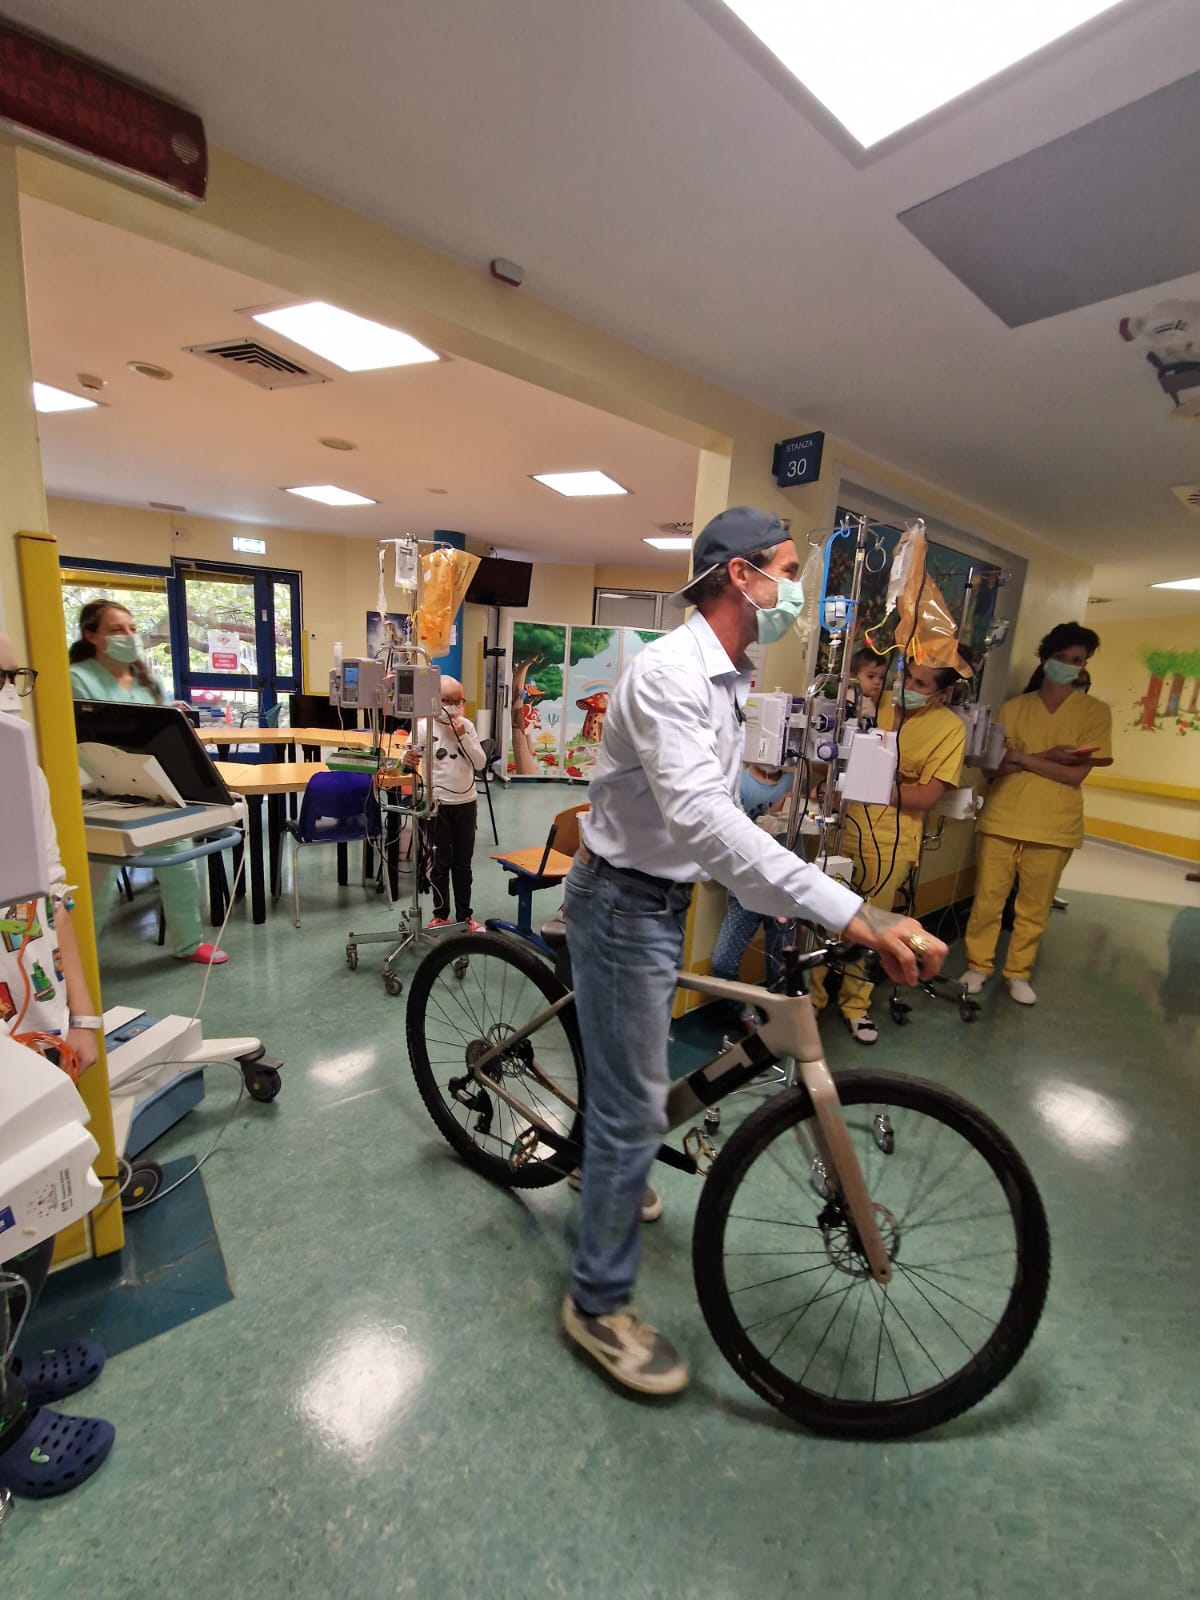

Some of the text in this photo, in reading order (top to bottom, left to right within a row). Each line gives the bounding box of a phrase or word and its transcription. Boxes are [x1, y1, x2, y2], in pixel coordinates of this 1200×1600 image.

[0, 37, 160, 128] LLARME
[786, 440, 814, 452] STANZA
[787, 458, 807, 478] 30
